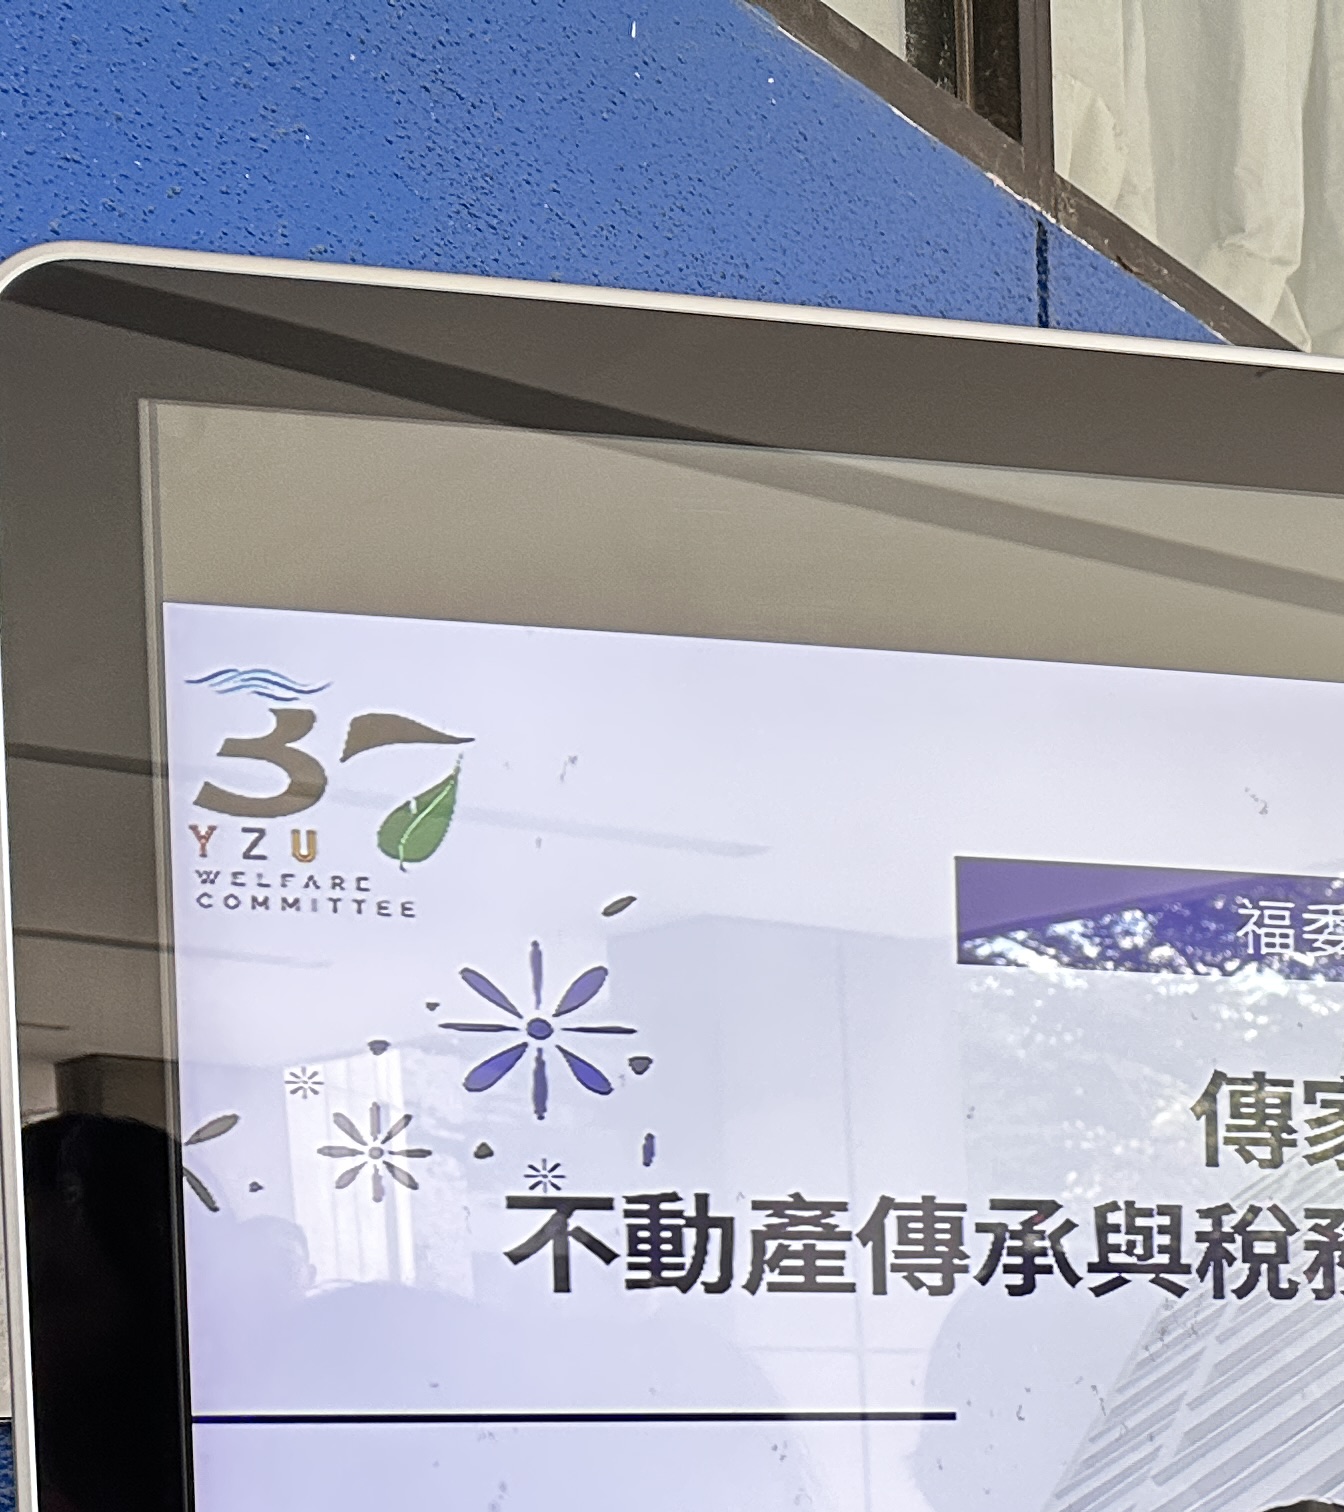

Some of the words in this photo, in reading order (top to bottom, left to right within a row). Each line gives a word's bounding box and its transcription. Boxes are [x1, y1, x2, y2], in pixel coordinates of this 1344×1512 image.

[188, 823, 318, 864] YZU
[195, 868, 371, 893] WELFARE
[196, 891, 416, 919] COMMITTEE
